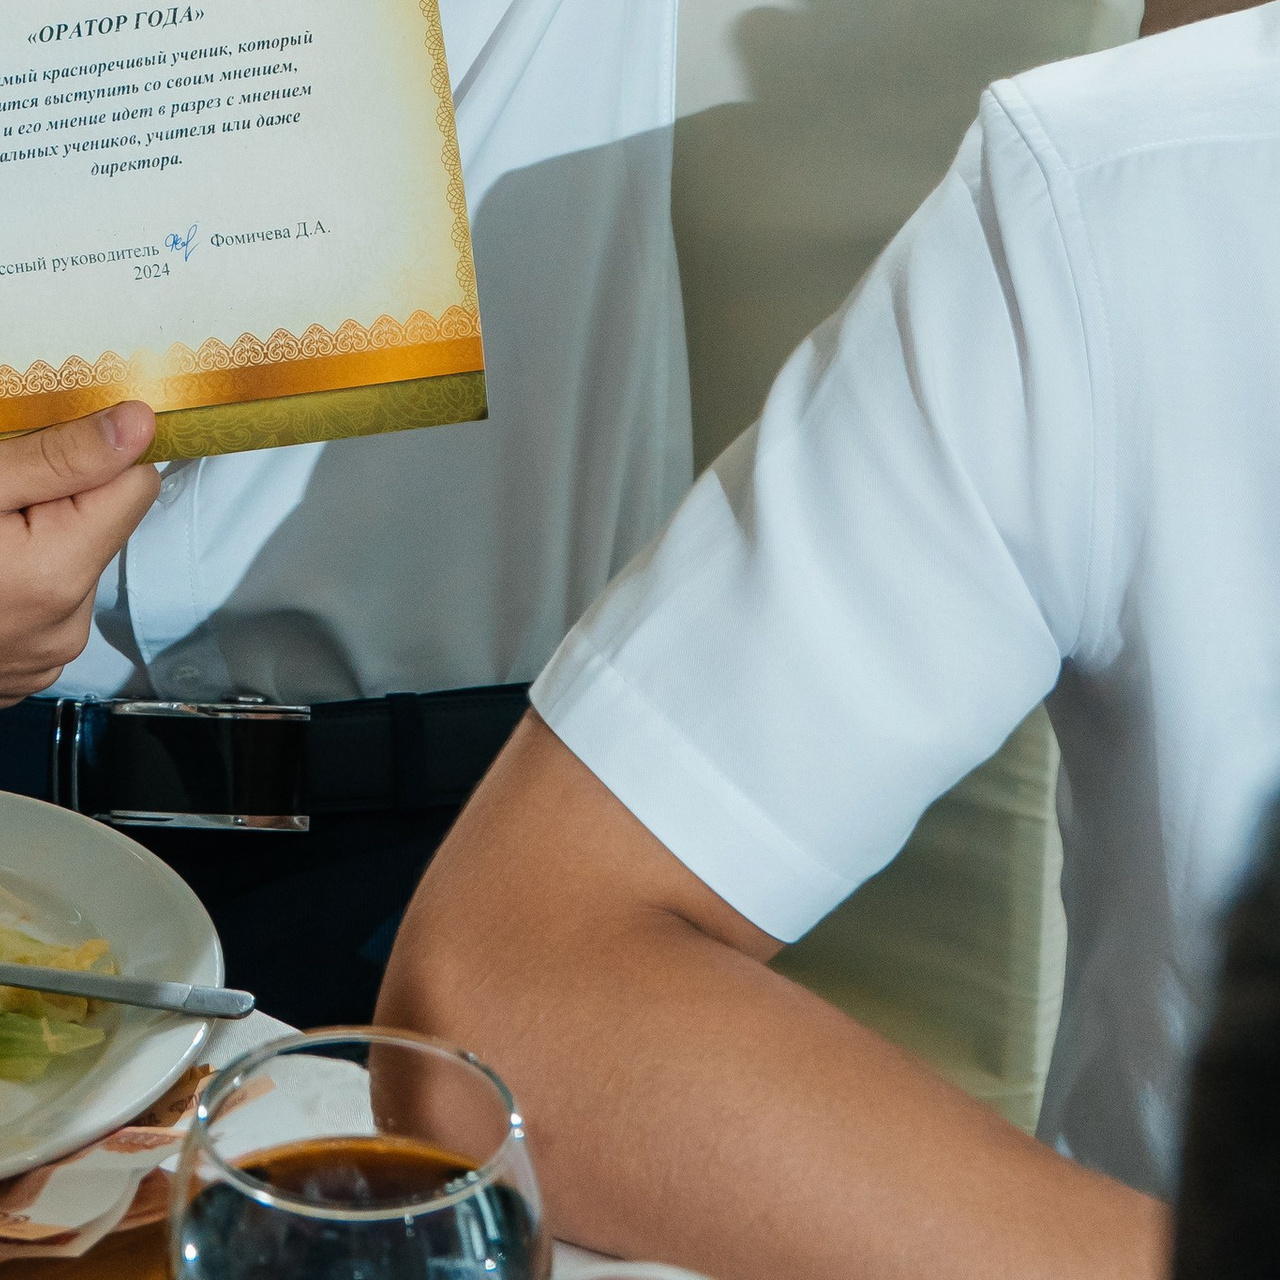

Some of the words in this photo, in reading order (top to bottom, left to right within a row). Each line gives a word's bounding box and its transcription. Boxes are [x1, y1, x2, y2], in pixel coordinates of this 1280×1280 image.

[27, 14, 128, 45] «ОРАТОР
[133, 5, 205, 31] ГОДА»
[42, 51, 168, 83] красноречивый
[171, 45, 233, 67] ученик,
[237, 30, 315, 54] который
[44, 83, 140, 107] выступить
[144, 80, 162, 92] со
[166, 72, 215, 90] своим
[219, 60, 299, 82] мнением,
[3, 126, 14, 137] и
[18, 122, 42, 135] его
[46, 112, 107, 132] мнение
[111, 105, 153, 123] идет
[158, 105, 166, 116] в
[170, 97, 221, 118] разрез
[226, 94, 235, 106] с
[238, 84, 312, 105] мнением
[62, 132, 142, 158] учеников,
[145, 123, 216, 147] учителя
[222, 118, 252, 134] или
[256, 112, 301, 129] даже
[90, 153, 183, 178] директора.
[51, 243, 160, 273] руководитель
[210, 226, 291, 249] Фомичева
[295, 220, 331, 240] Д.А.
[133, 262, 171, 281] 2024
